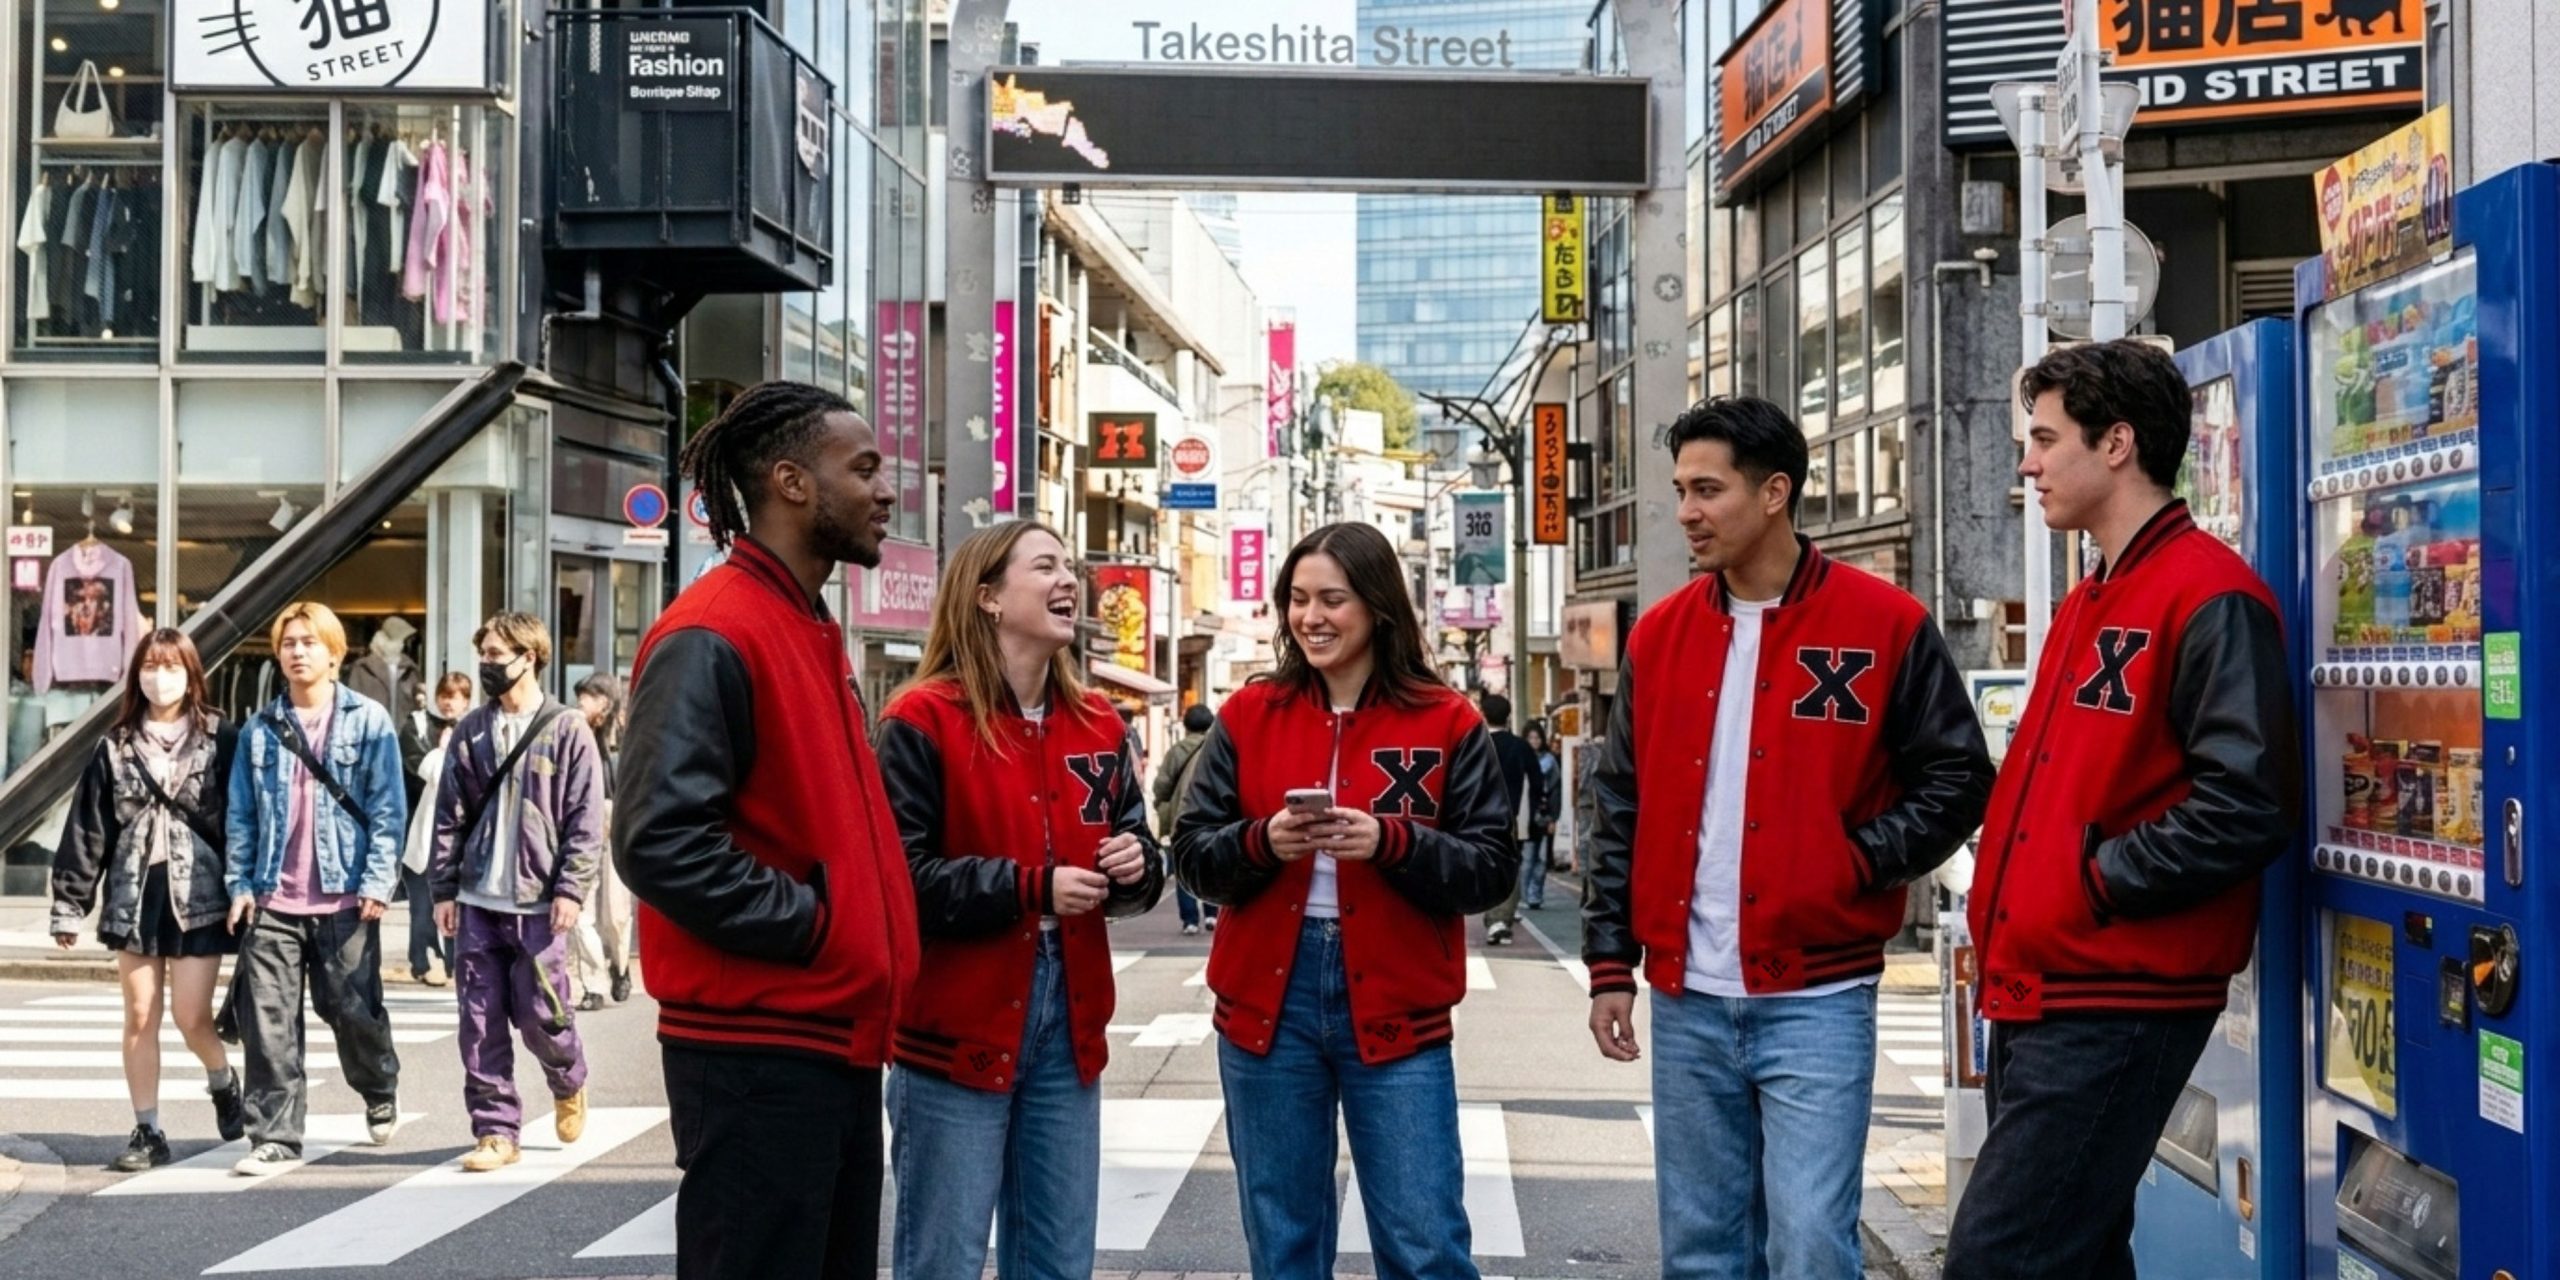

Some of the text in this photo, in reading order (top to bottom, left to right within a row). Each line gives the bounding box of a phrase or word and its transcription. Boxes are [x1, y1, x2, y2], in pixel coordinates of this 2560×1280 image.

[307, 40, 405, 81] STREET
[629, 53, 724, 76] Fashion
[1132, 21, 1514, 67] Takeshita Street
[2204, 55, 2406, 101] STREET
[1792, 646, 1875, 725] X
[2074, 626, 2151, 715] X
[1370, 747, 1443, 819] X
